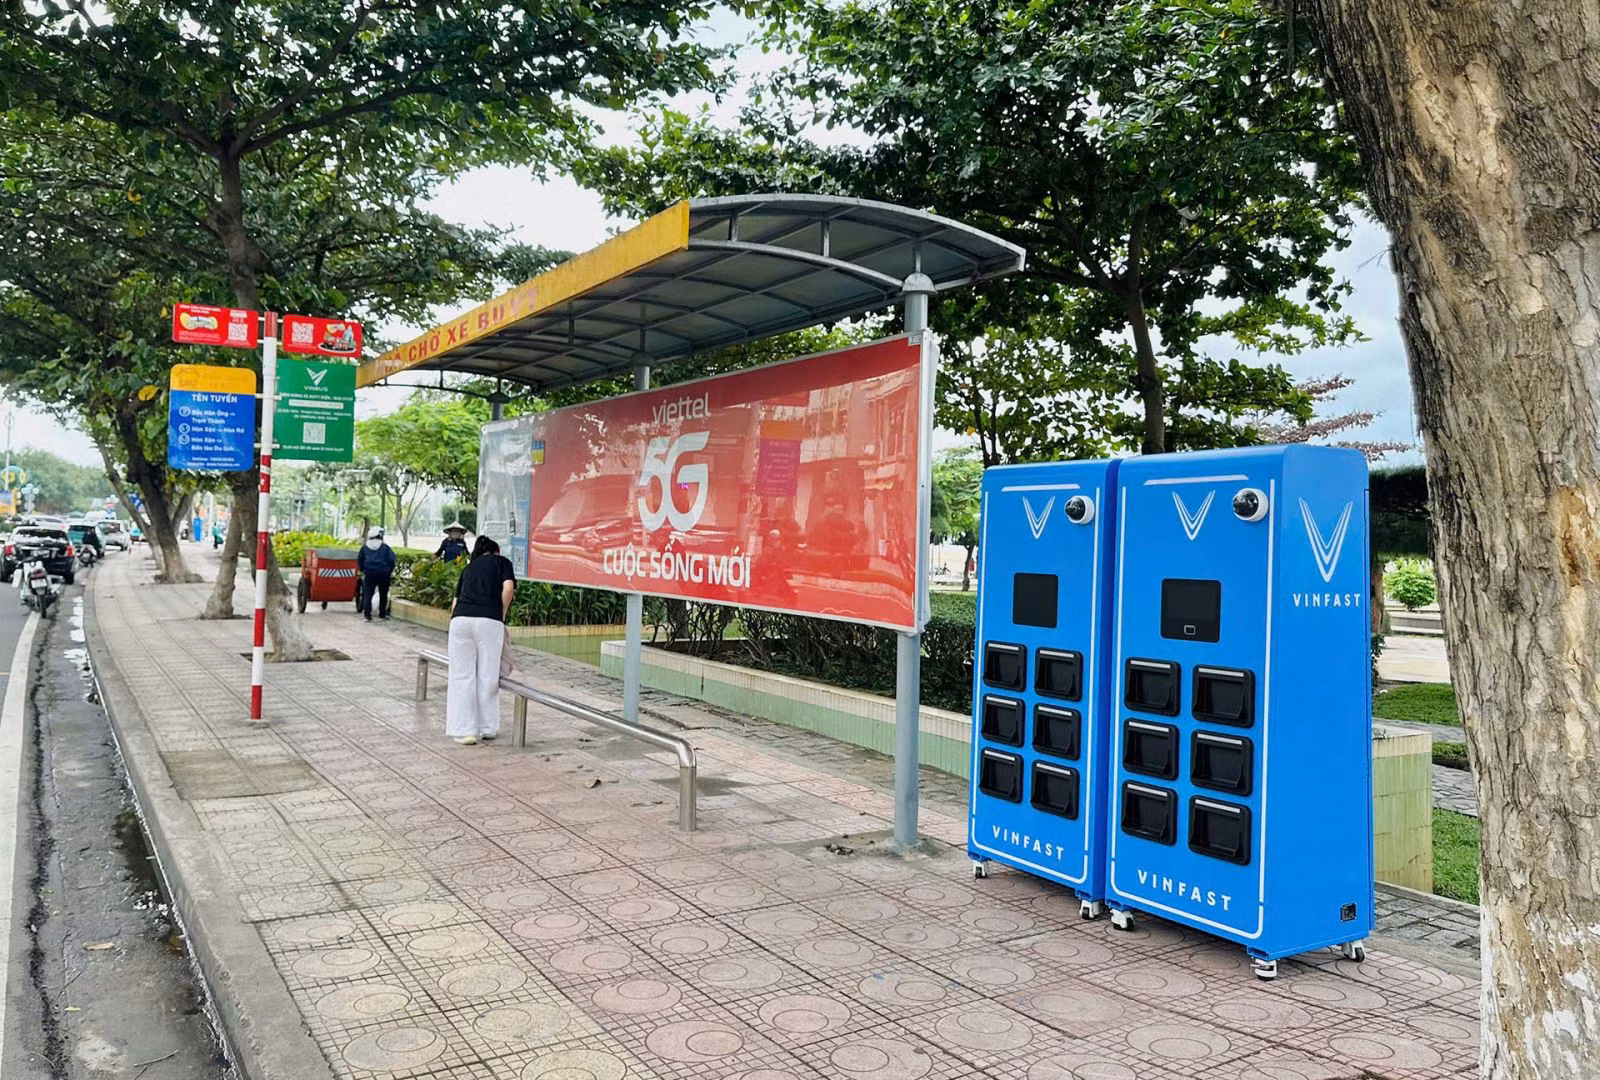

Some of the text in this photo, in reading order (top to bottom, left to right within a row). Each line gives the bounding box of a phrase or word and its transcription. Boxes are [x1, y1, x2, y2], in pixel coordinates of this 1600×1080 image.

[448, 320, 468, 345] XE
[192, 393, 238, 403] TÊN TUYẾN
[652, 392, 710, 426] viettel
[638, 430, 710, 533] 5G
[603, 543, 751, 588] CUỘC SỐNG MỚI
[1293, 592, 1361, 608] VINFAST
[992, 824, 1065, 861] VINFAST
[1138, 868, 1233, 912] VINFAST
